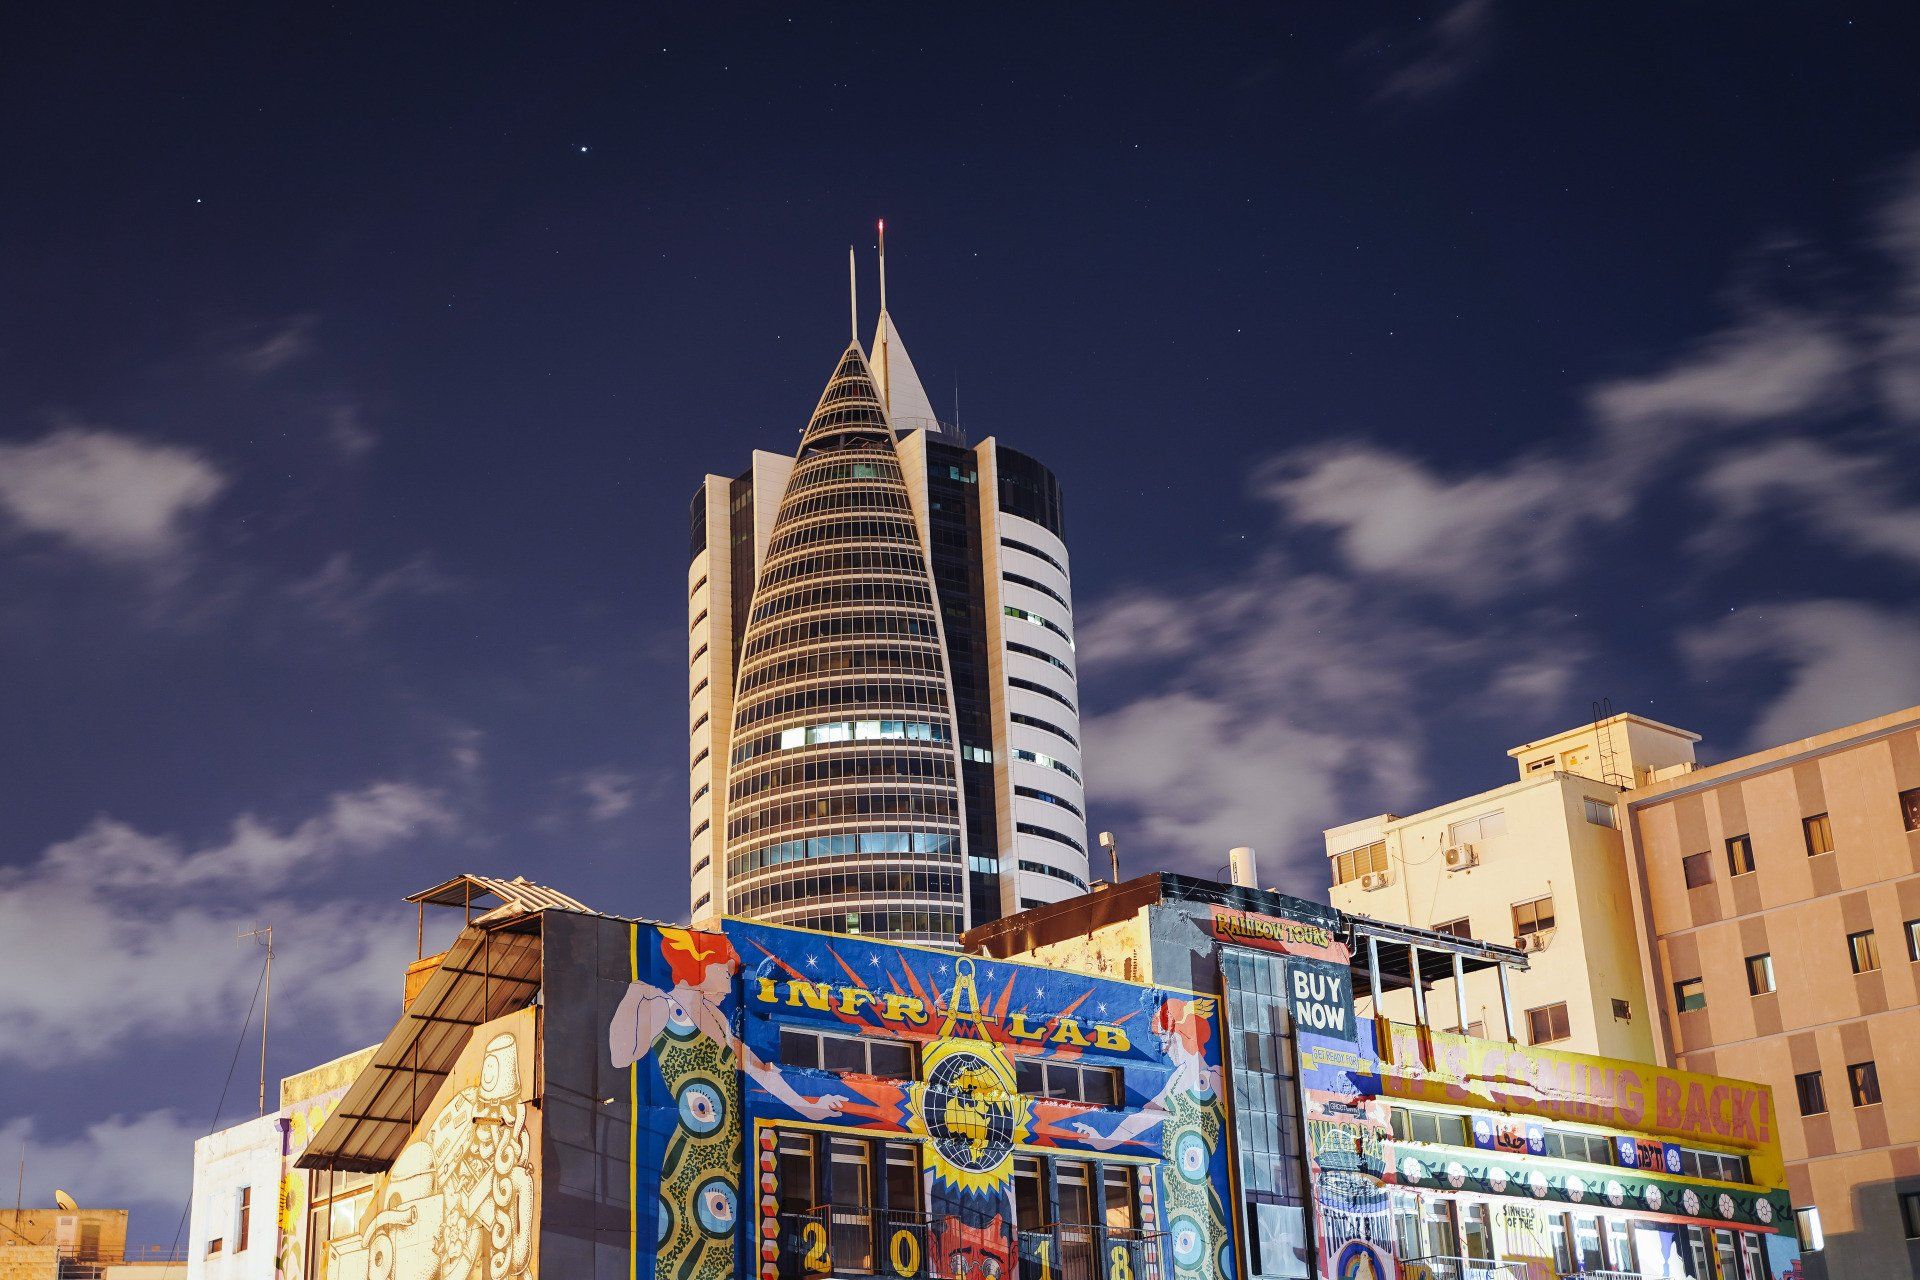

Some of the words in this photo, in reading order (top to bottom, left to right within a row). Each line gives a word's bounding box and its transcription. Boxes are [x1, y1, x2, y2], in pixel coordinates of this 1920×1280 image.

[1216, 913, 1283, 942] RAINBOW
[1285, 924, 1329, 948] TOURS
[1293, 970, 1341, 1002] BUY
[1296, 1001, 1345, 1031] NOW
[1008, 1012, 1131, 1052] LAB
[1312, 1048, 1325, 1060] GET
[1326, 1050, 1344, 1063] READY
[1346, 1053, 1358, 1066] FOR
[1482, 1050, 1645, 1126] COMING
[1656, 1075, 1770, 1143] BACK!
[1496, 1123, 1526, 1153] حيفا
[1637, 1143, 1664, 1170] חיפה
[1503, 1204, 1535, 1218] SINNERS
[1507, 1217, 1518, 1228] OF
[1519, 1217, 1534, 1230] THE
